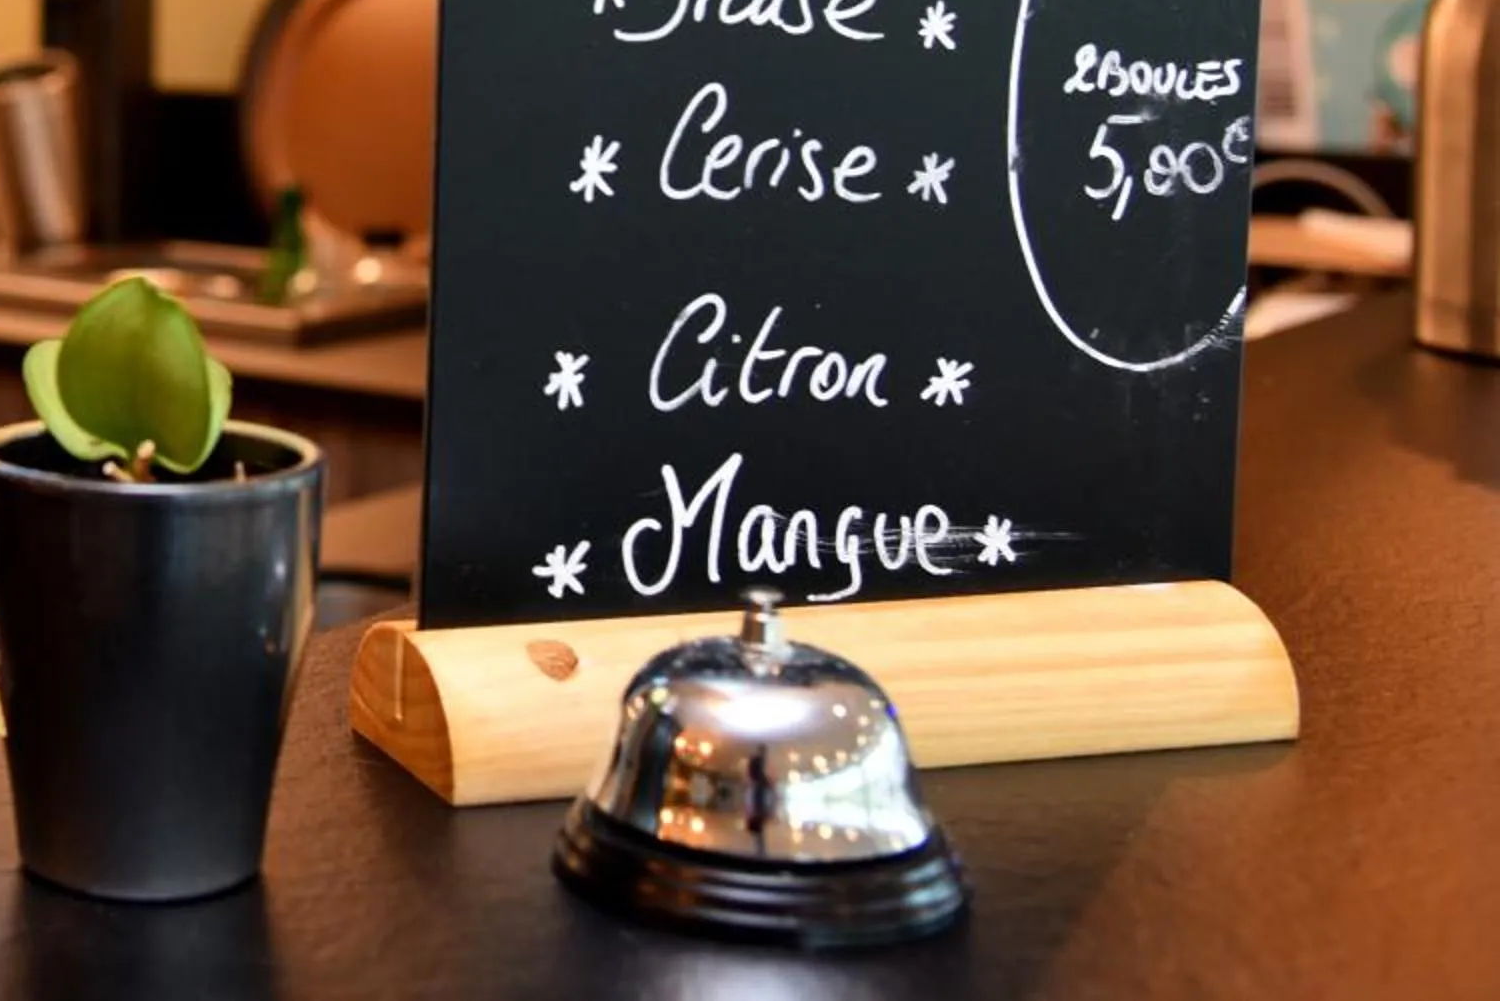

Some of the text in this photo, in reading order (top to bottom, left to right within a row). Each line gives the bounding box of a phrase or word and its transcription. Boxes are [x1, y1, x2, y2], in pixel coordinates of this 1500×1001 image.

[659, 81, 883, 203] Cerise
[648, 292, 890, 412] Citron
[621, 452, 954, 602] Mangue
